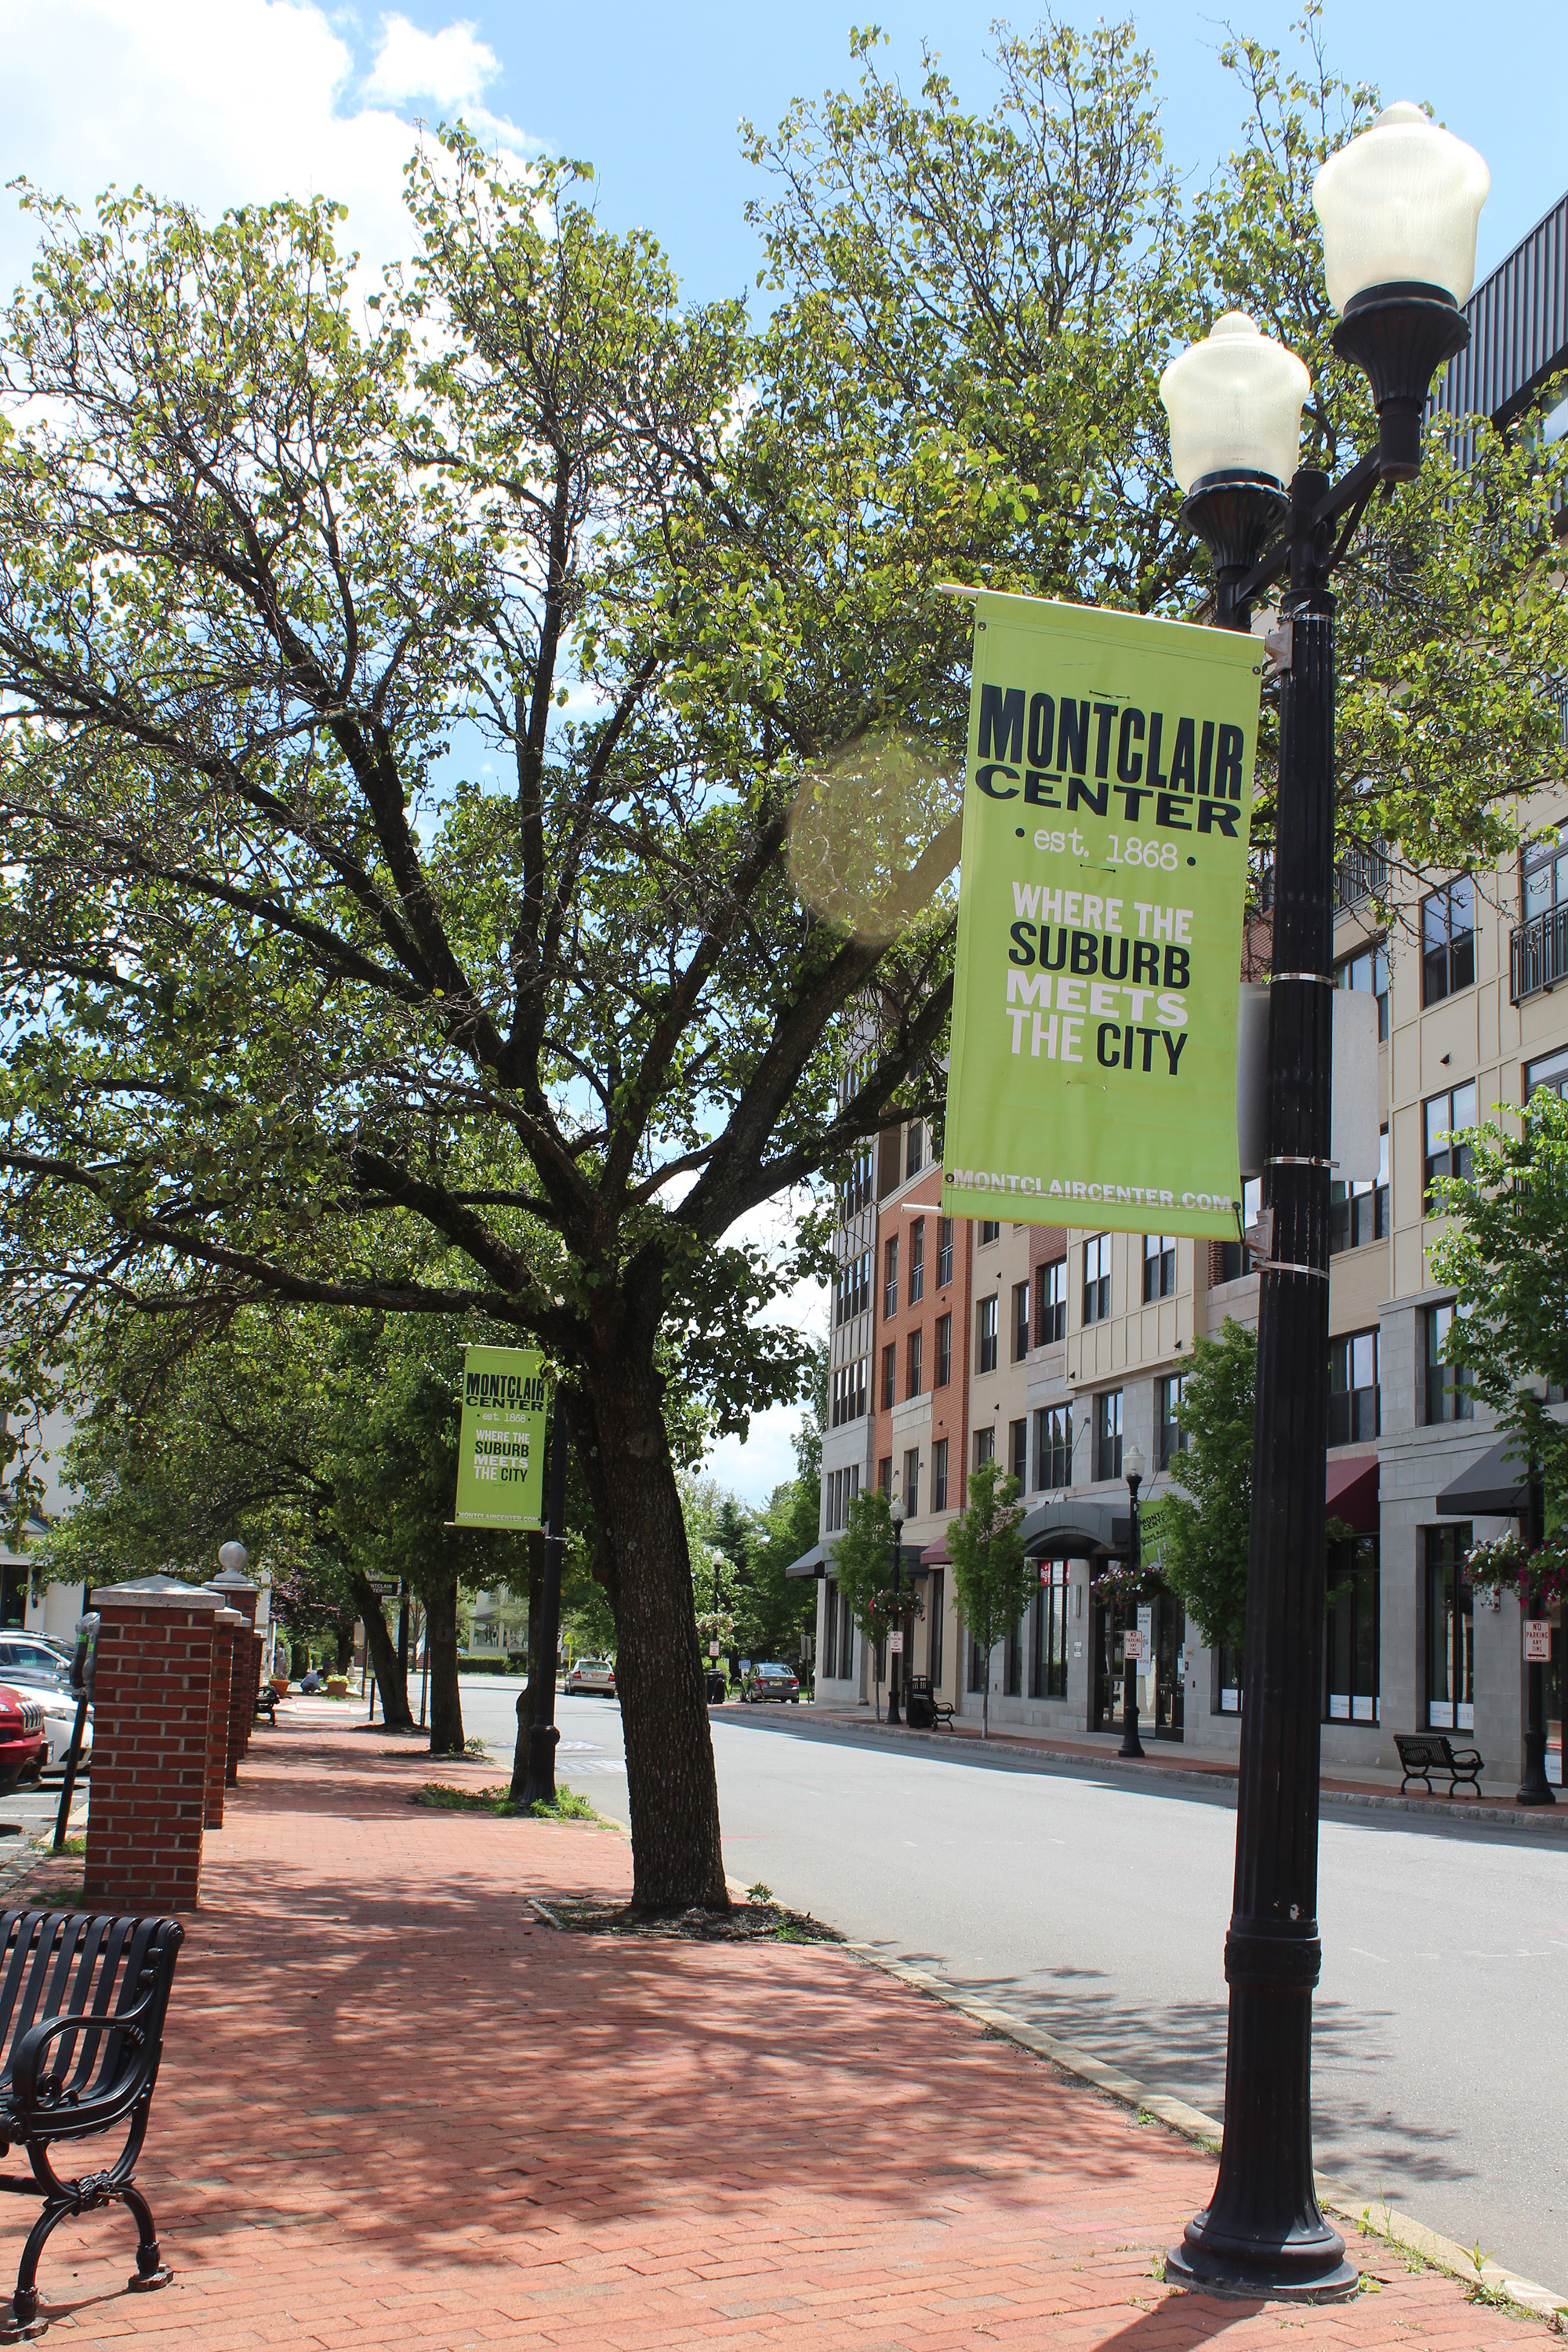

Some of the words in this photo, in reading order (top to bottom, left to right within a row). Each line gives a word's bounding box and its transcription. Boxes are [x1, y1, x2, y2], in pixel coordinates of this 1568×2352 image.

[978, 683, 1245, 800] MONTCLAIR
[975, 764, 1242, 838] CENTER
[1033, 827, 1090, 858] est.
[1106, 834, 1178, 872] 1868
[1012, 881, 1123, 933] WHERE
[1134, 902, 1194, 945] THE
[1008, 921, 1191, 989] SUBURB
[1006, 969, 1189, 1027] MEETS
[1006, 1007, 1085, 1063] THE
[1097, 1022, 1189, 1076] CITY
[953, 1168, 1232, 1212] MONTCLAIRCENTER.COM
[466, 1373, 545, 1401] MONTCLAIR
[465, 1396, 544, 1412] CENTER
[482, 1412, 500, 1421] est.
[504, 1413, 526, 1423] 1868
[474, 1441, 529, 1457] SUBURB
[476, 1429, 510, 1443] WHERE
[513, 1432, 530, 1444] THE
[474, 1455, 528, 1468] MEETS
[474, 1465, 498, 1480] THE
[501, 1468, 528, 1483] CITY
[1140, 1510, 1167, 1526] MONTC
[1142, 1516, 1172, 1531] CENTE
